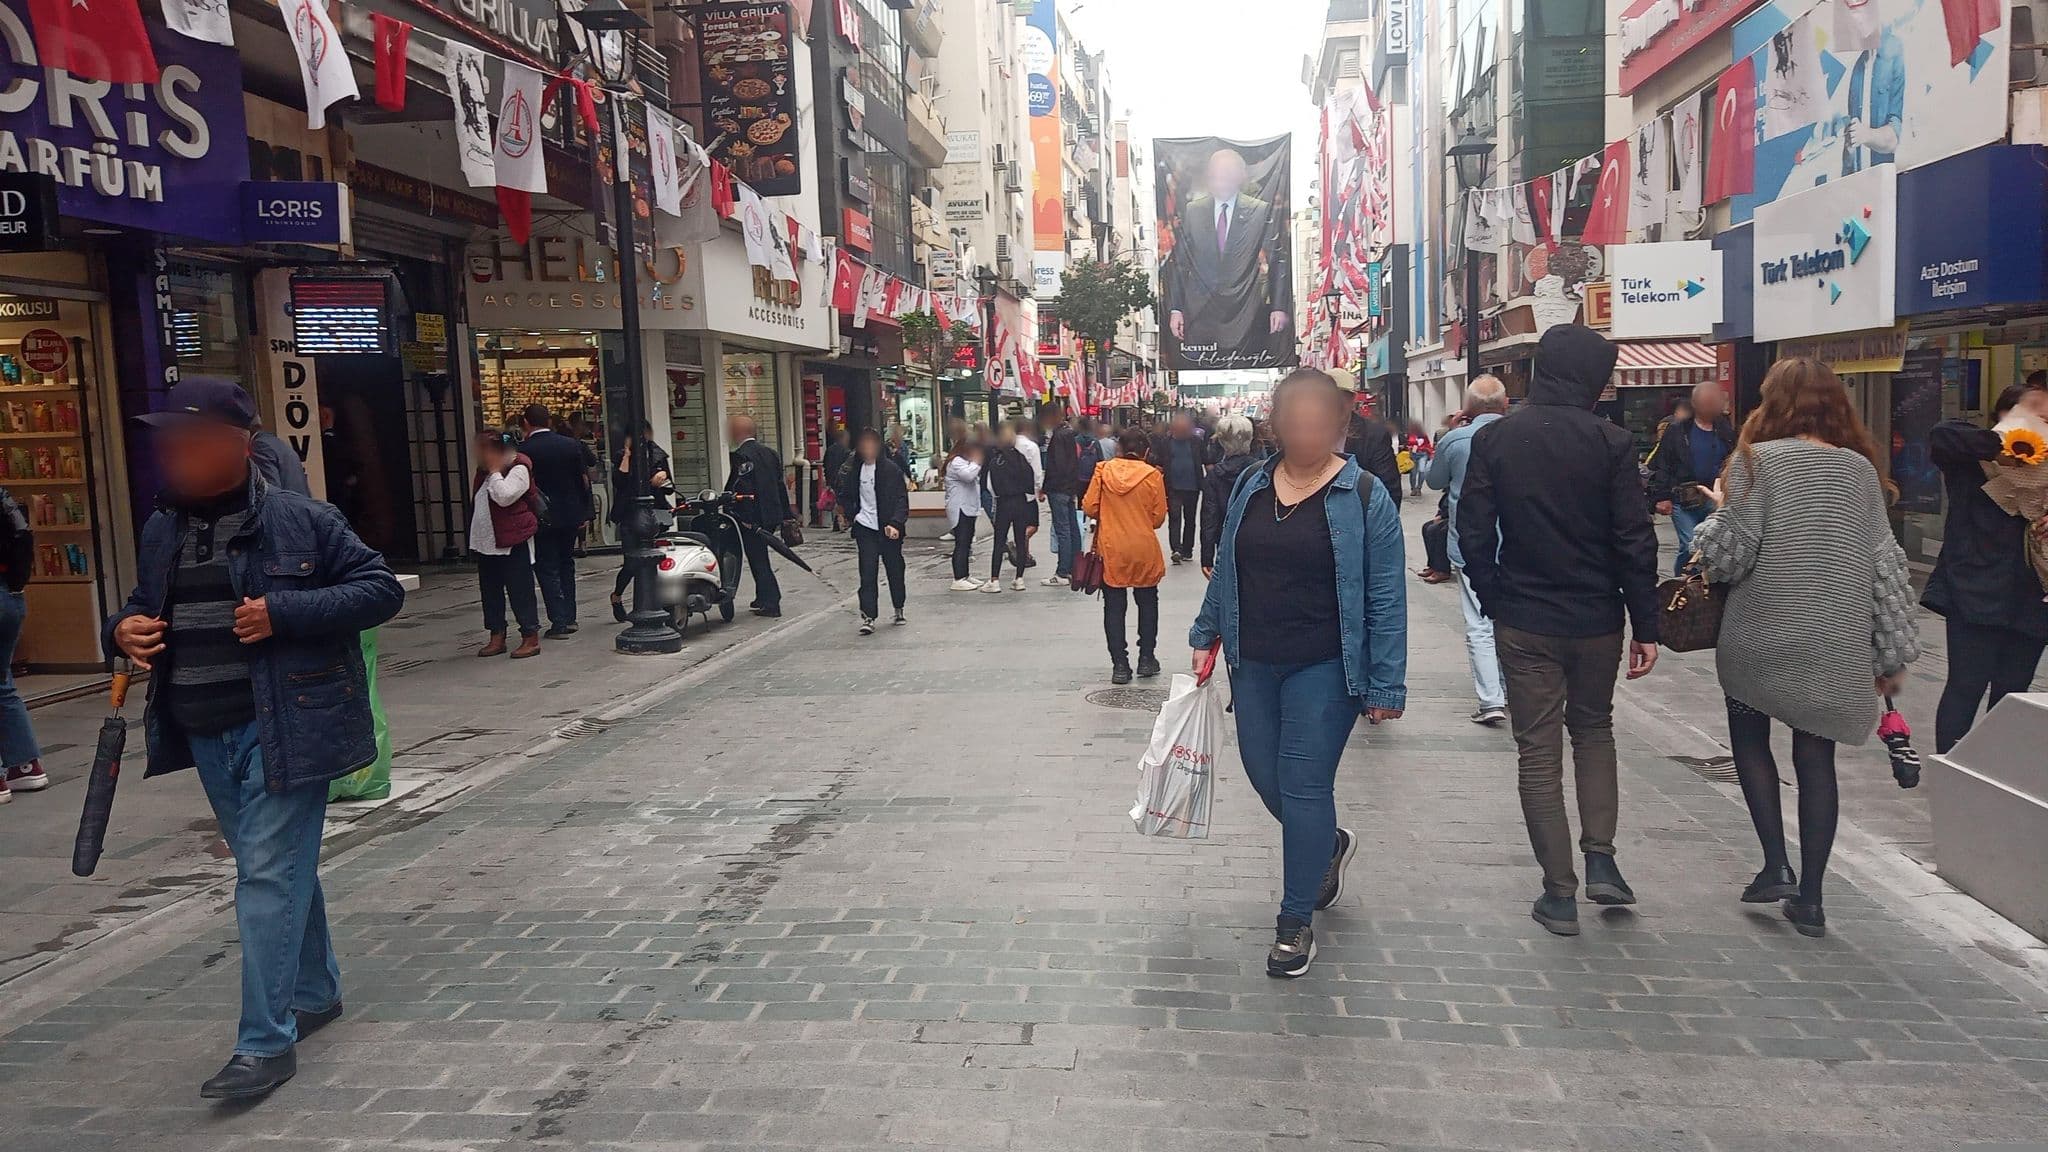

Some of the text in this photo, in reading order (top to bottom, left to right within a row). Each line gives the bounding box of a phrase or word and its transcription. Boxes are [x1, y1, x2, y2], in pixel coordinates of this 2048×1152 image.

[0, 221, 28, 234] EUR
[1761, 249, 1845, 285] Türk Telekom
[1920, 259, 1979, 280] Aziz Dostum
[1621, 278, 1651, 290] Türk
[1621, 292, 1680, 304] Telekom
[749, 306, 805, 330] ACCESSORIES
[1180, 342, 1217, 352] kemal
[283, 361, 311, 478] DÖV
